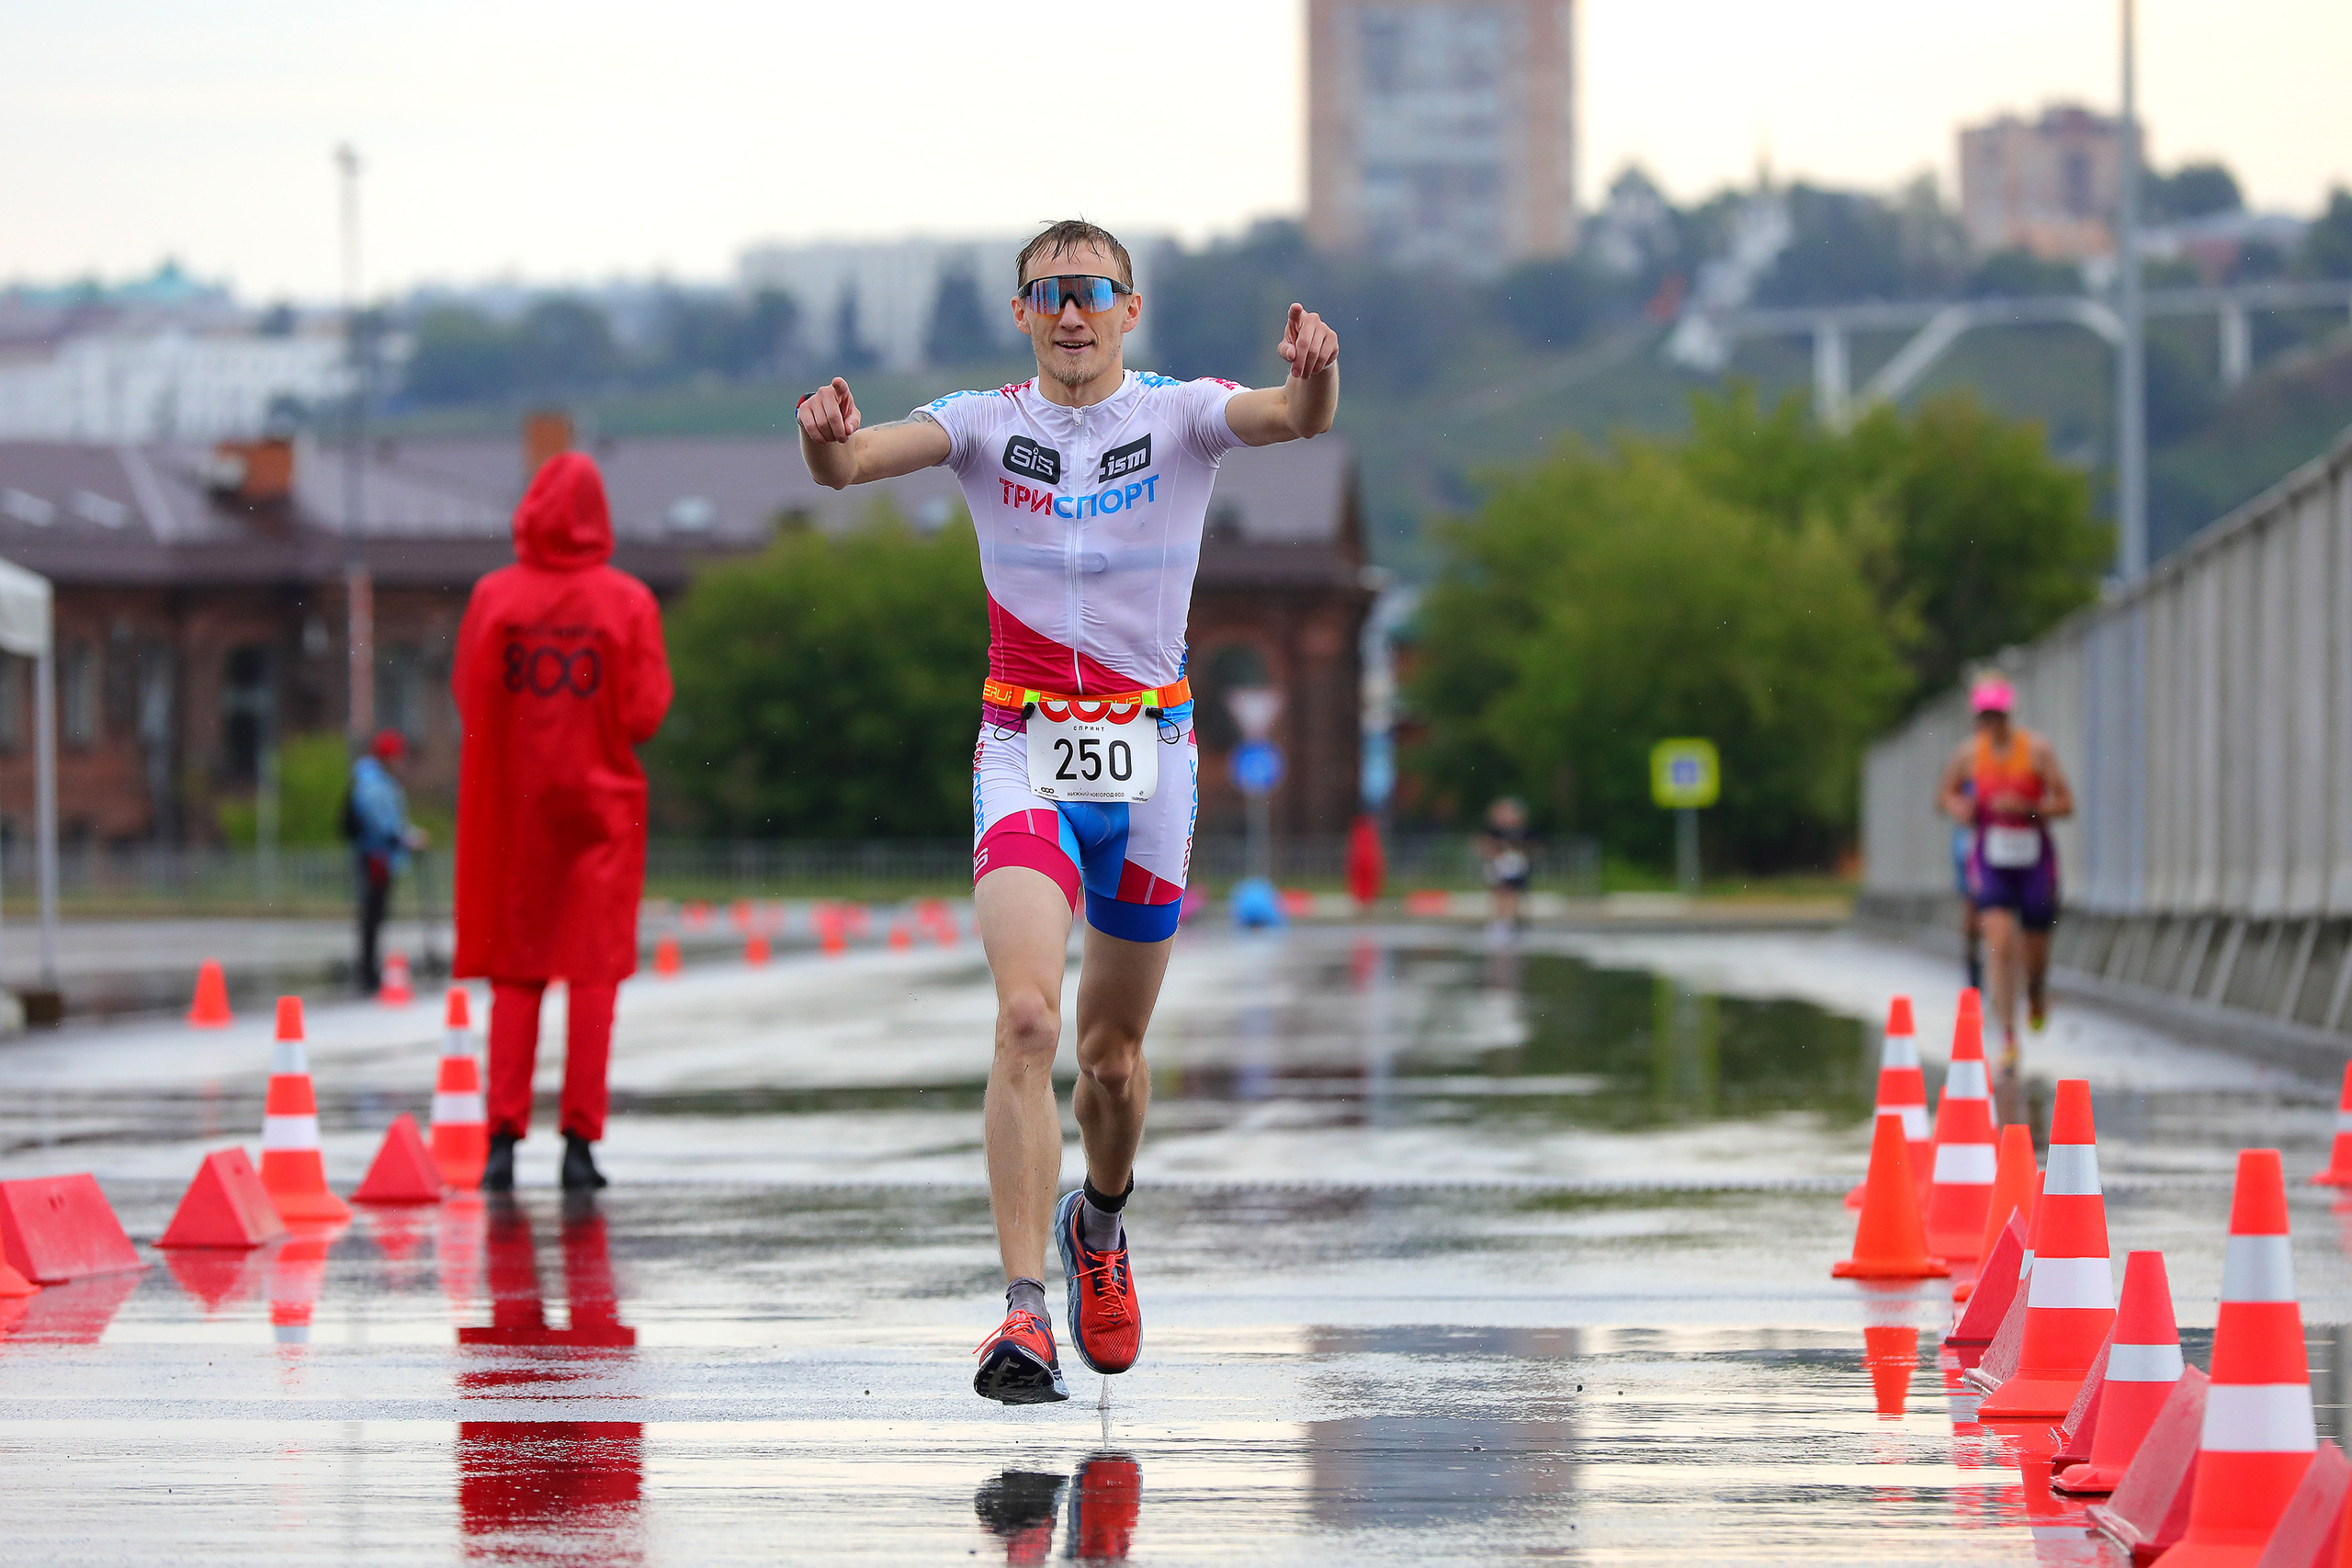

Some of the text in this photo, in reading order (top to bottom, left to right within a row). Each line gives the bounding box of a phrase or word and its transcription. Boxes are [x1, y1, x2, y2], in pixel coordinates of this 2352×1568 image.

[999, 474, 1159, 519] ТРИСПОРТ
[503, 642, 602, 698] 800
[1054, 738, 1133, 782] 250
